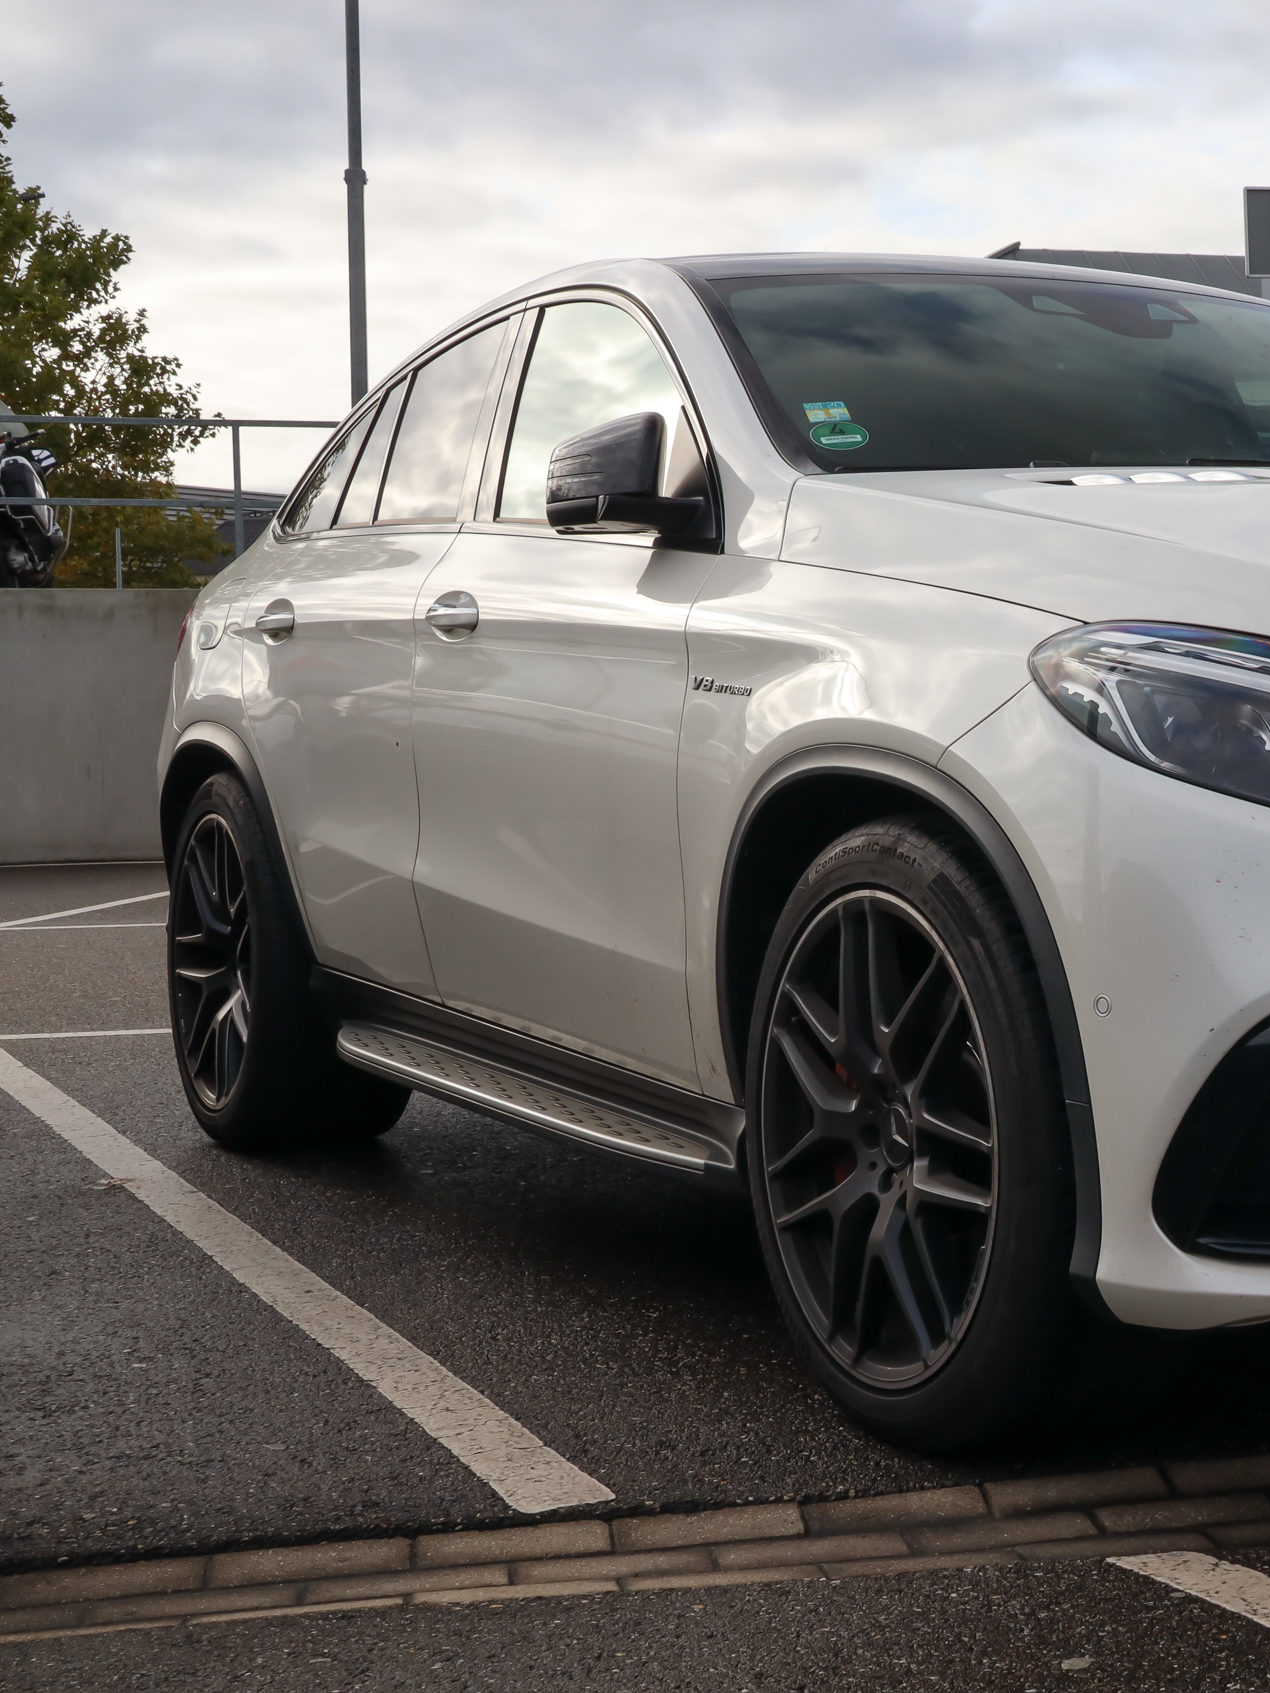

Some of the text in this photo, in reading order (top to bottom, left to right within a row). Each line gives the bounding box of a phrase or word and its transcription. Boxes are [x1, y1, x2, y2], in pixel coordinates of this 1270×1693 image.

[830, 424, 846, 435] 4
[692, 676, 752, 696] V8 BITURBO
[814, 841, 918, 875] ContiSportContact
